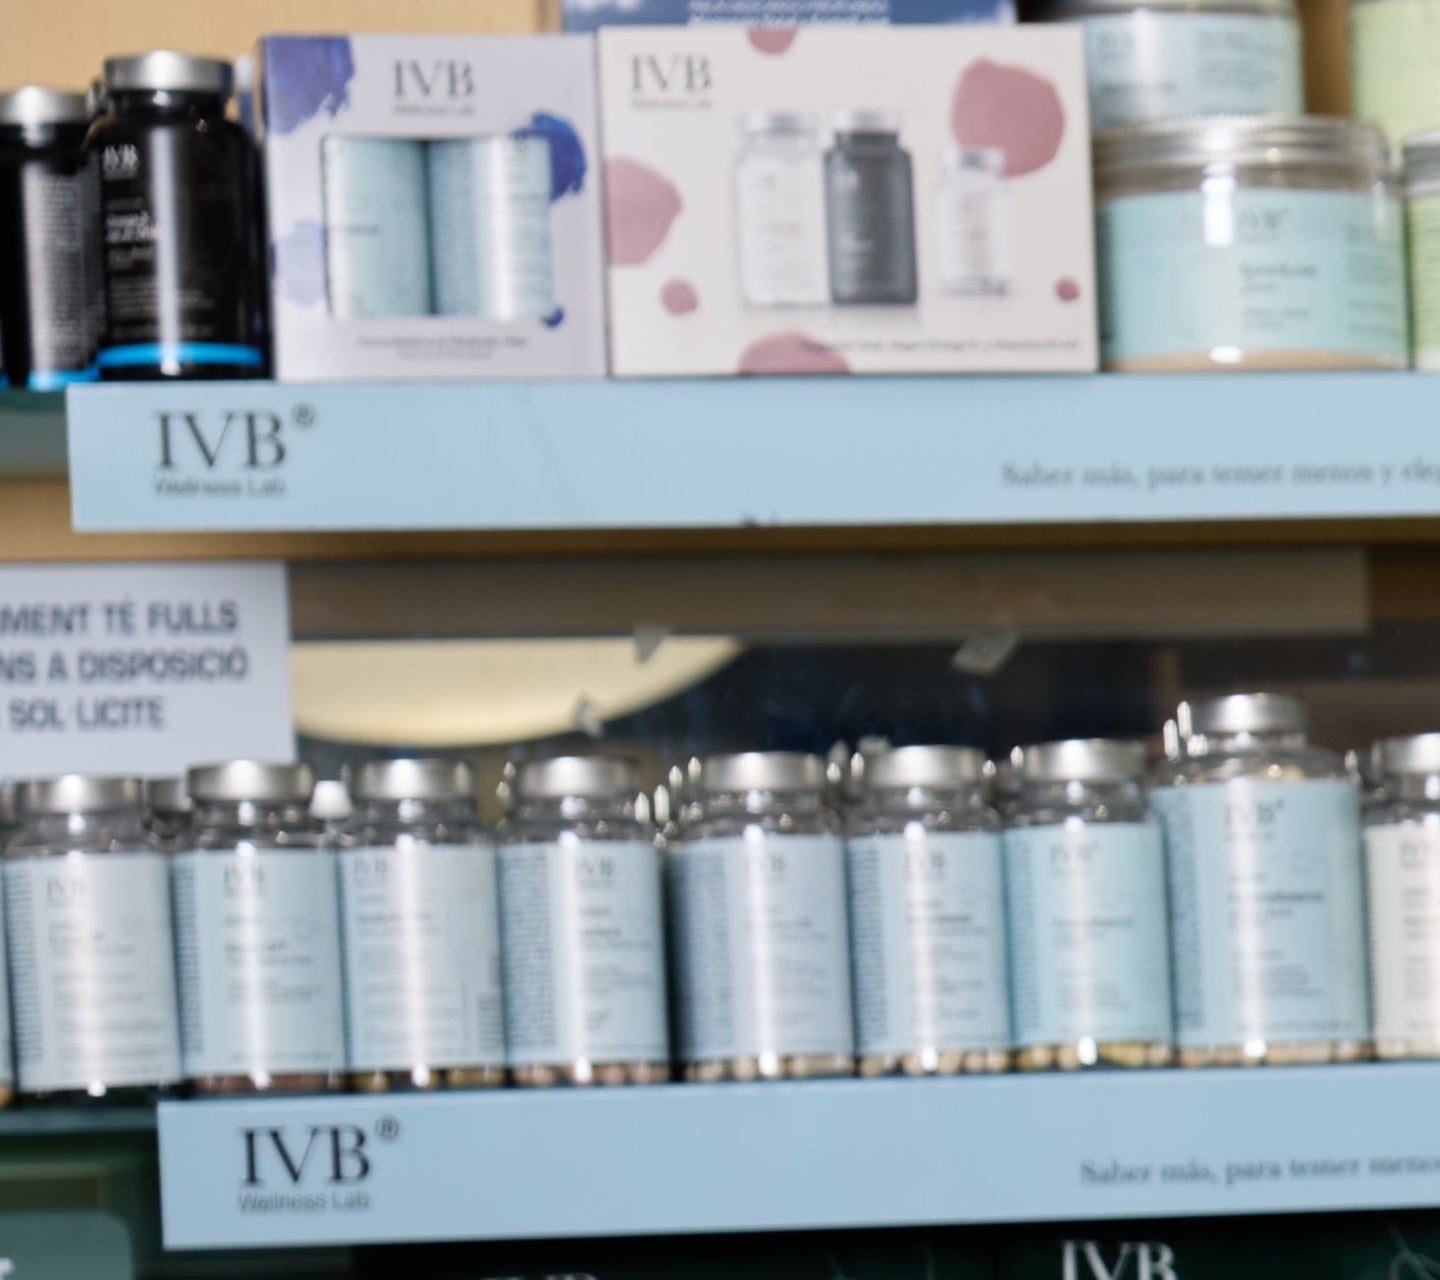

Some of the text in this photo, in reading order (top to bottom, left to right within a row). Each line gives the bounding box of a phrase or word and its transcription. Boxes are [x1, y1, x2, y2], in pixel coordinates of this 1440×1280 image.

[393, 58, 476, 99] IVB
[630, 53, 714, 94] IVB
[246, 477, 286, 496] Lab
[1000, 459, 1075, 489] Saber
[1148, 463, 1206, 492] para
[1210, 460, 1285, 486] temer
[1291, 460, 1375, 485] menos
[1380, 462, 1398, 491] y
[103, 598, 136, 635] TÉ
[147, 600, 238, 632] FULLS
[47, 658, 67, 682] A
[78, 645, 250, 679] DISPOSICIÓ
[1080, 1158, 1153, 1186] Saber
[1224, 1160, 1281, 1188] para
[1288, 1157, 1362, 1182] temer
[237, 1190, 370, 1213] Wellness Lab
